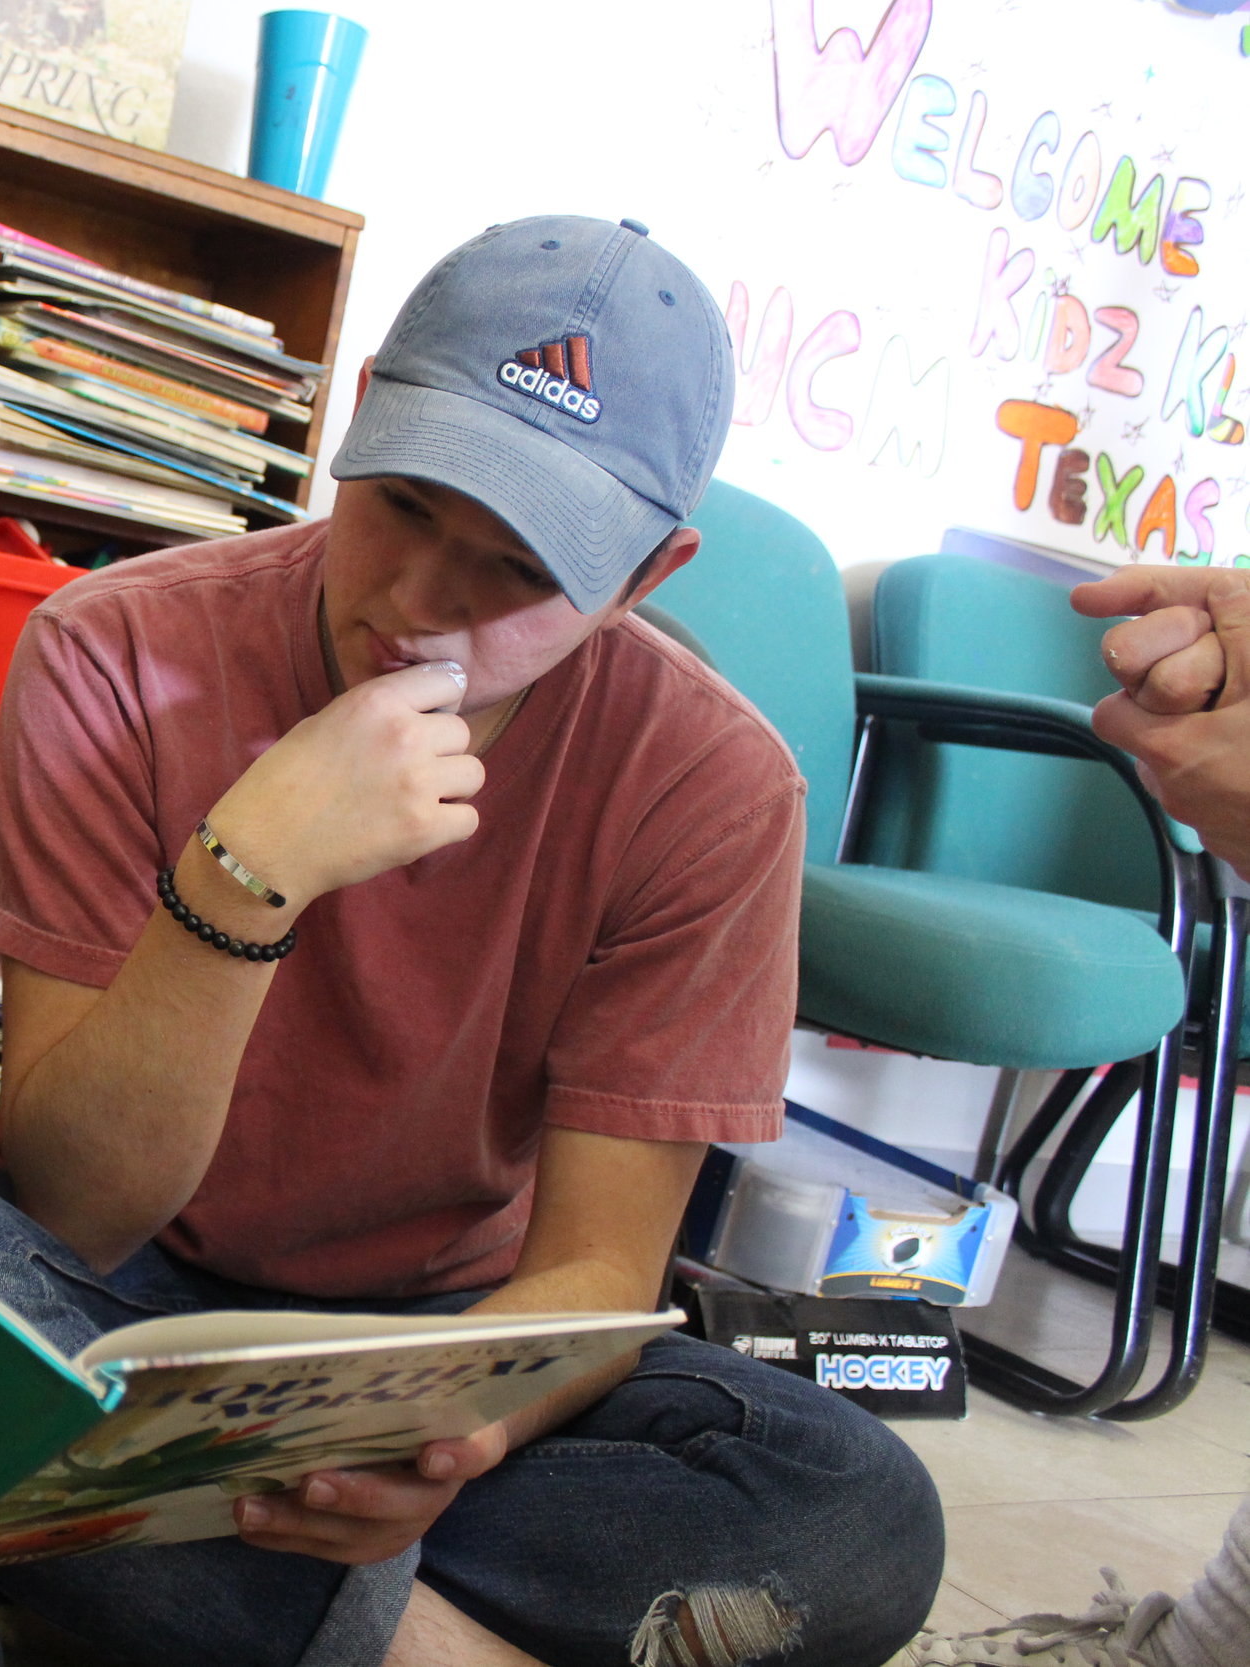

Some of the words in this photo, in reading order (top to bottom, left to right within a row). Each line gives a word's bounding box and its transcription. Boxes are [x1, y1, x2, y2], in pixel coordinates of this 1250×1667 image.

[770, 0, 1212, 277] WELCOME
[500, 362, 600, 419] adidas
[995, 398, 1221, 567] TEXAS
[833, 1332, 888, 1348] LUMEN-X
[888, 1334, 949, 1349] TABLETOP
[357, 1352, 581, 1390] THAT
[815, 1353, 951, 1391] HOCKEY
